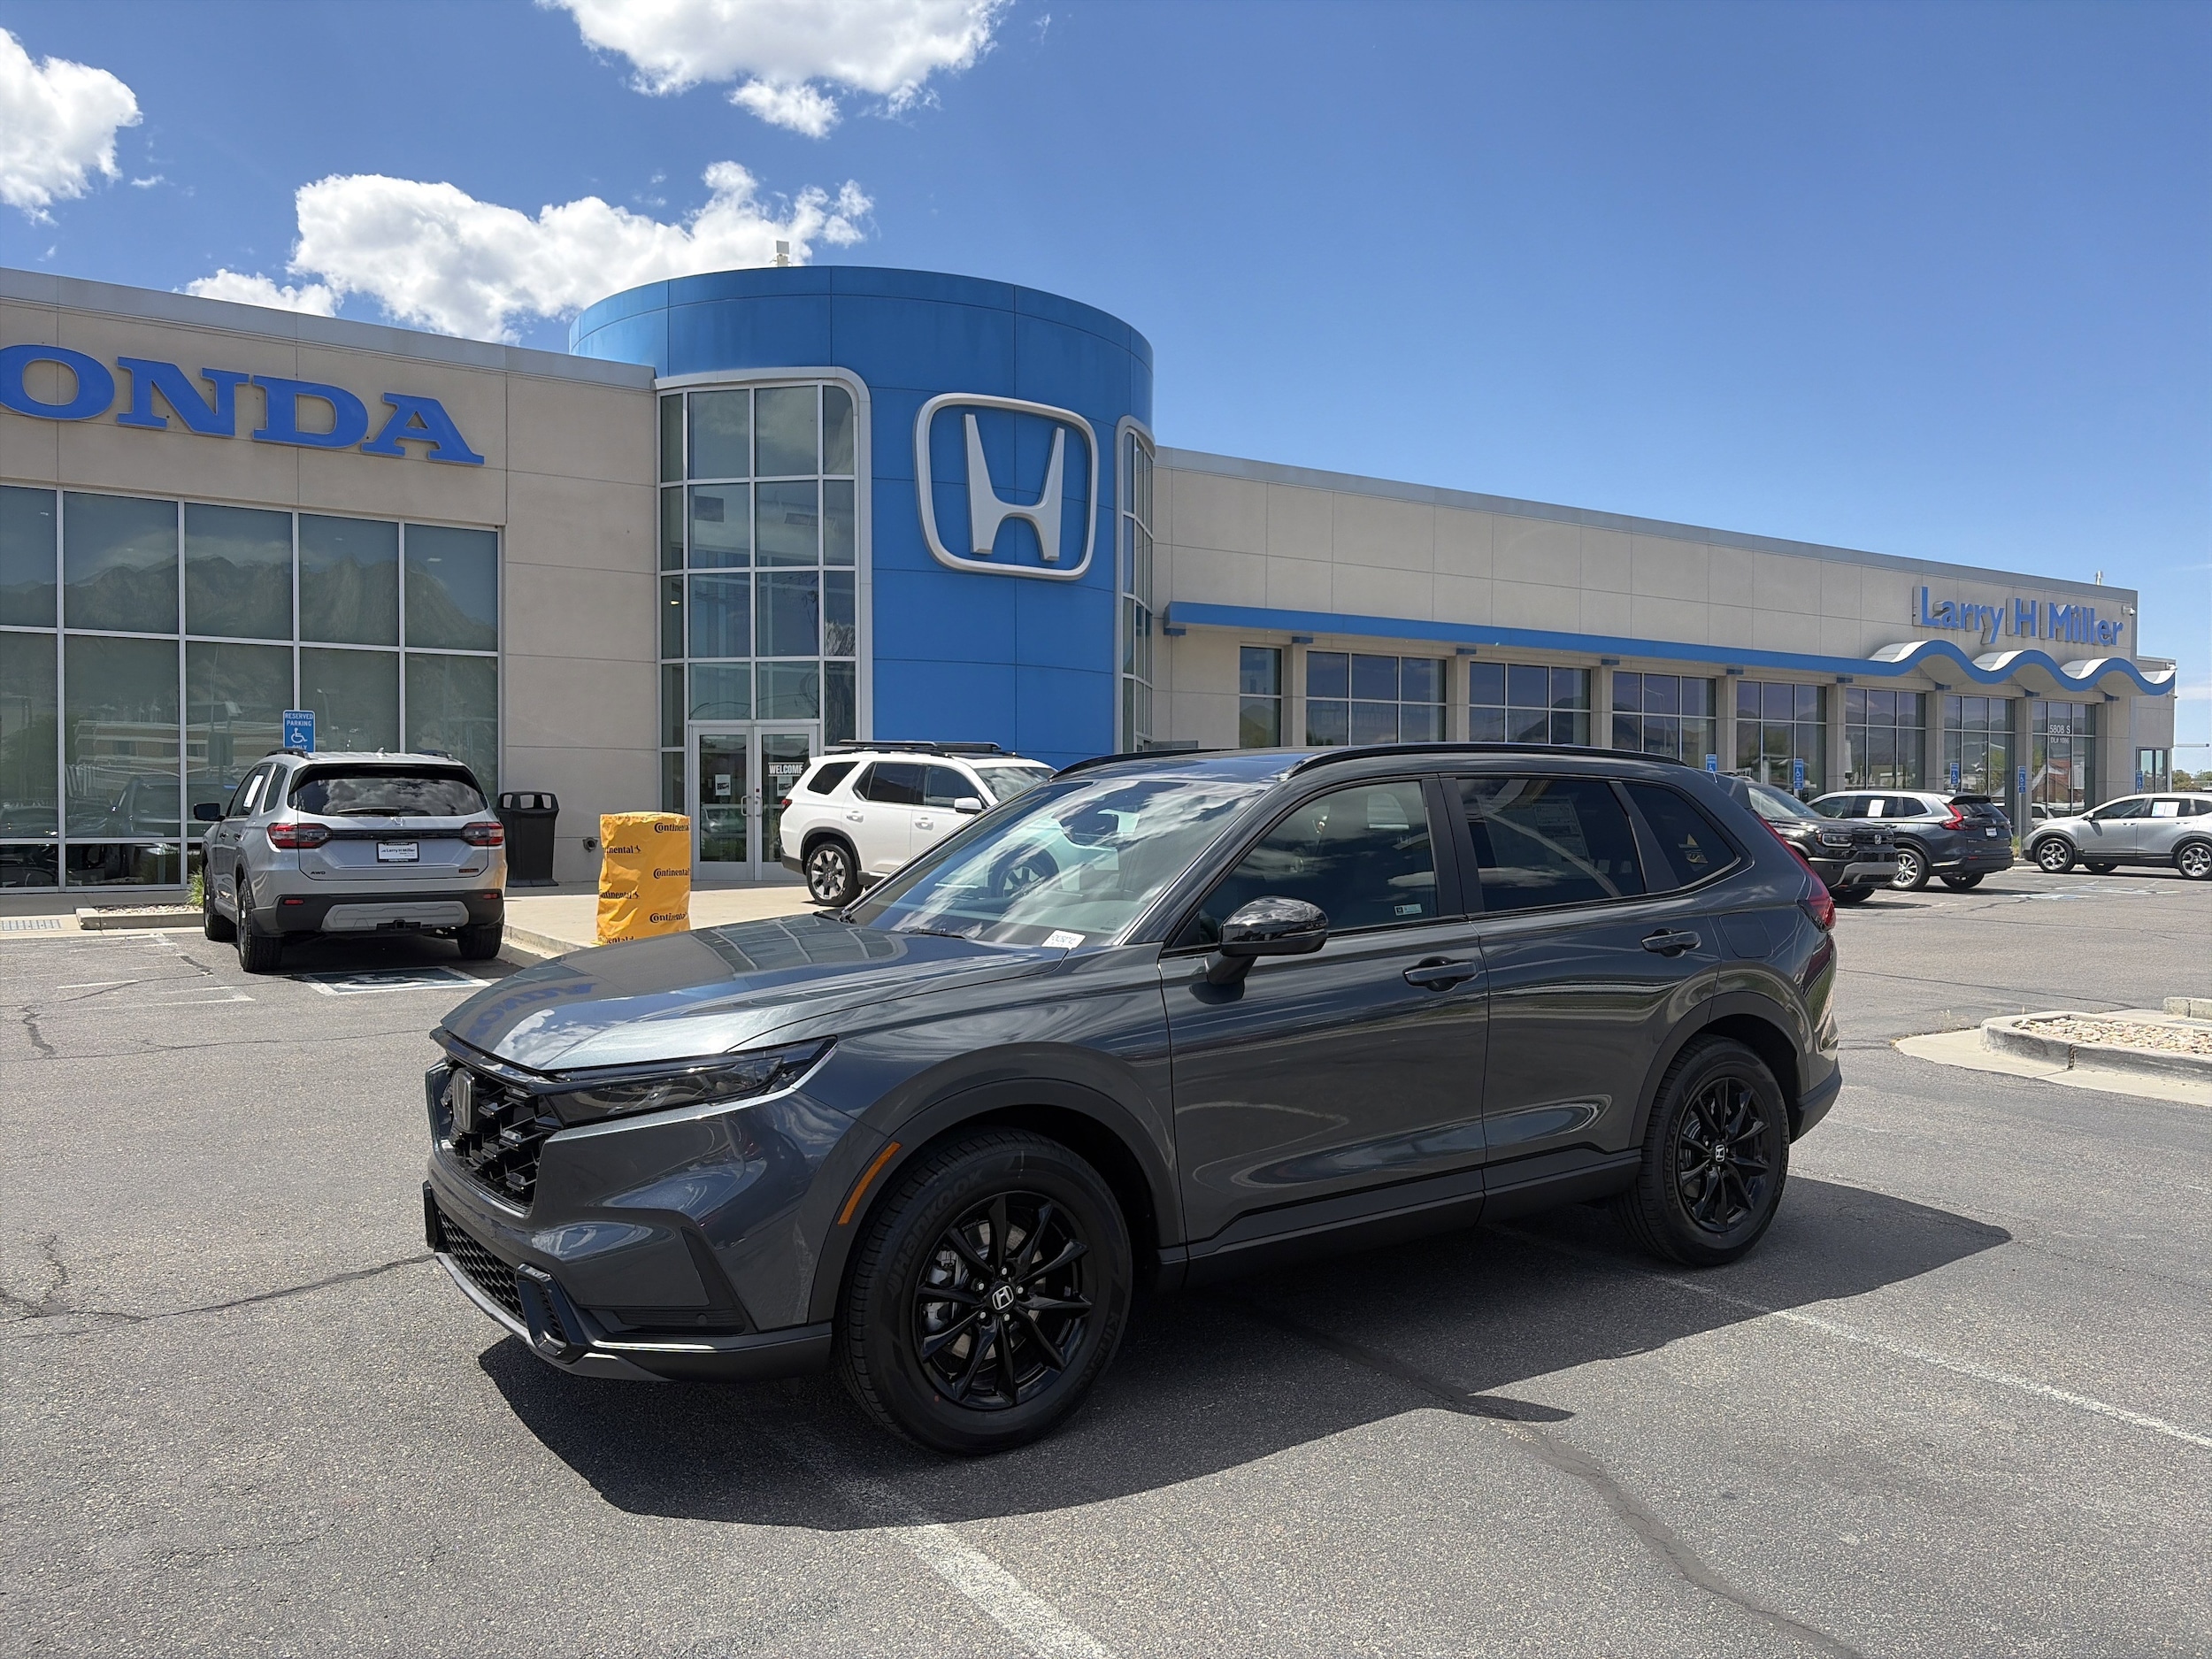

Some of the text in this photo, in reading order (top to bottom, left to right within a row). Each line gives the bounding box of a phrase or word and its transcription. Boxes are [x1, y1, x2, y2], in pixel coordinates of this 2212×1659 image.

[0, 343, 485, 465] ONDA
[1921, 586, 2124, 646] Larry H Miller
[2066, 726, 2071, 734] S
[769, 764, 803, 774] WELCOME
